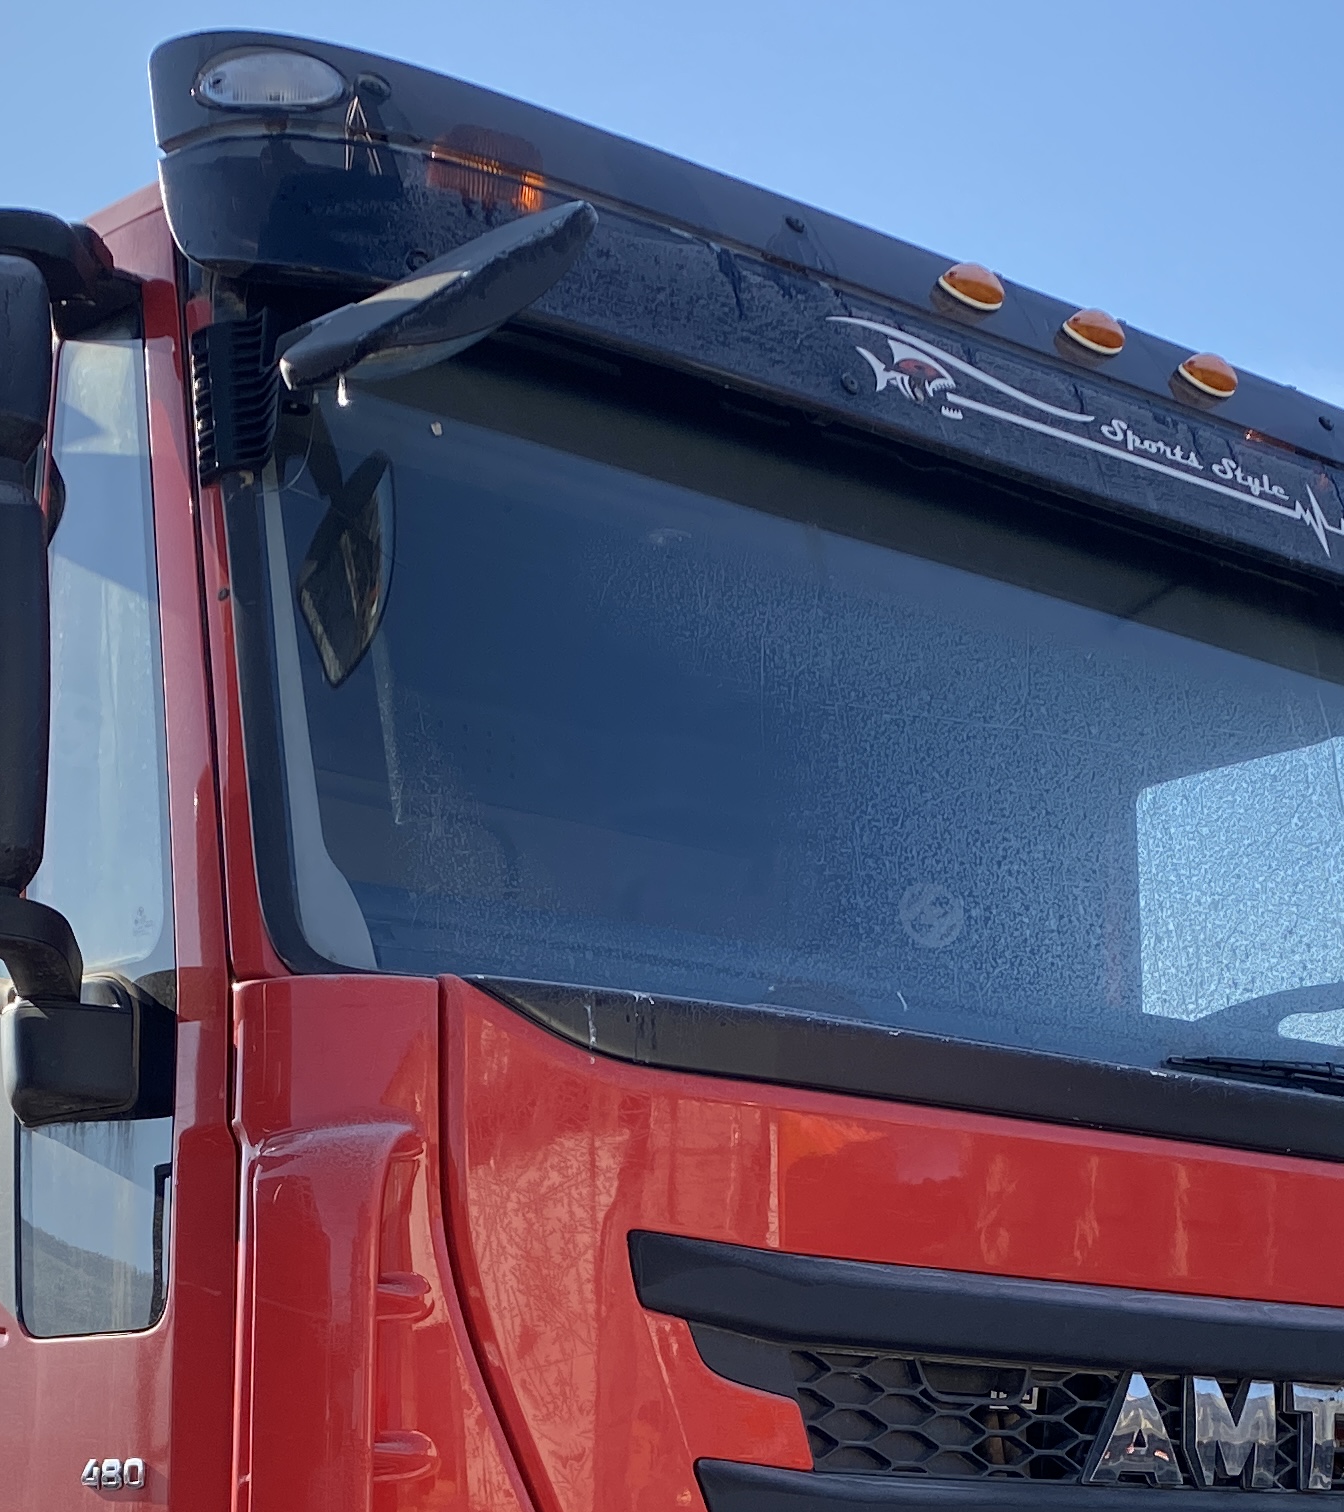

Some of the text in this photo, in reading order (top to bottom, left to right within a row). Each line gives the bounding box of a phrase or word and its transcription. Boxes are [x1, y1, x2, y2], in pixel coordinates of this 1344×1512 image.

[1100, 418, 1289, 501] Sports Style
[81, 1457, 145, 1491] 480
